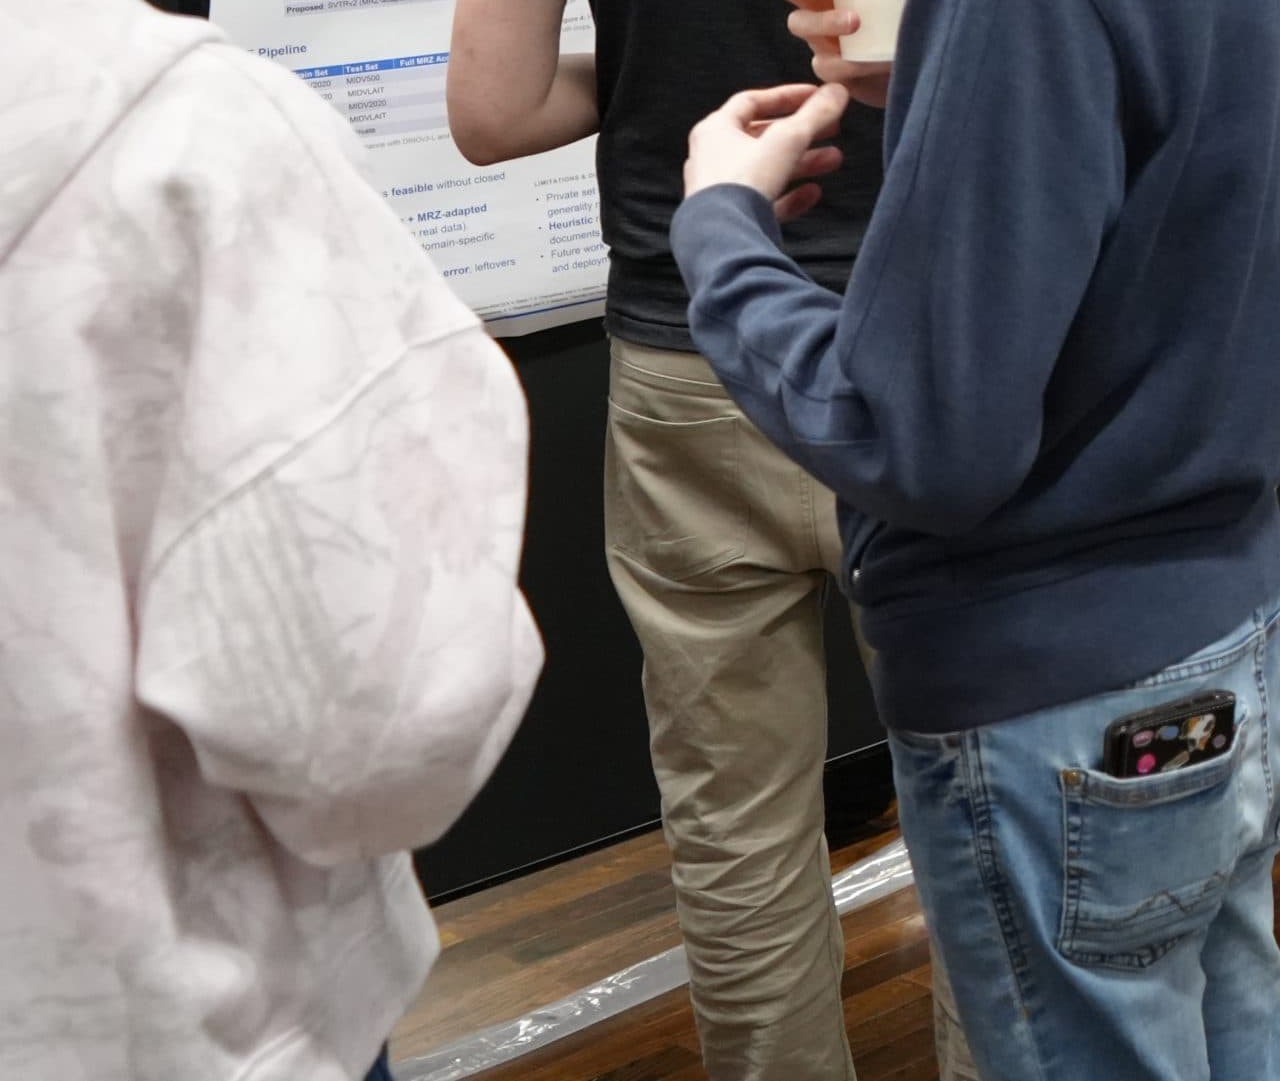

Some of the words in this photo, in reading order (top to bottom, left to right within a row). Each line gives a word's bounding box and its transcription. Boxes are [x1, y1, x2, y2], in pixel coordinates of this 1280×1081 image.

[259, 44, 307, 58] Pipeline
[346, 63, 362, 73] Test
[365, 62, 377, 72] Set
[391, 183, 433, 197] feasible
[435, 176, 471, 191] without
[473, 171, 505, 186] closed
[545, 190, 579, 201] Private
[581, 186, 596, 197] set
[417, 204, 487, 222] MRZ-adapted
[546, 202, 592, 216] generality
[418, 225, 438, 237] real
[440, 222, 466, 236] data)
[549, 216, 593, 230] Heuristic
[550, 246, 580, 259] Future
[551, 260, 570, 273] and
